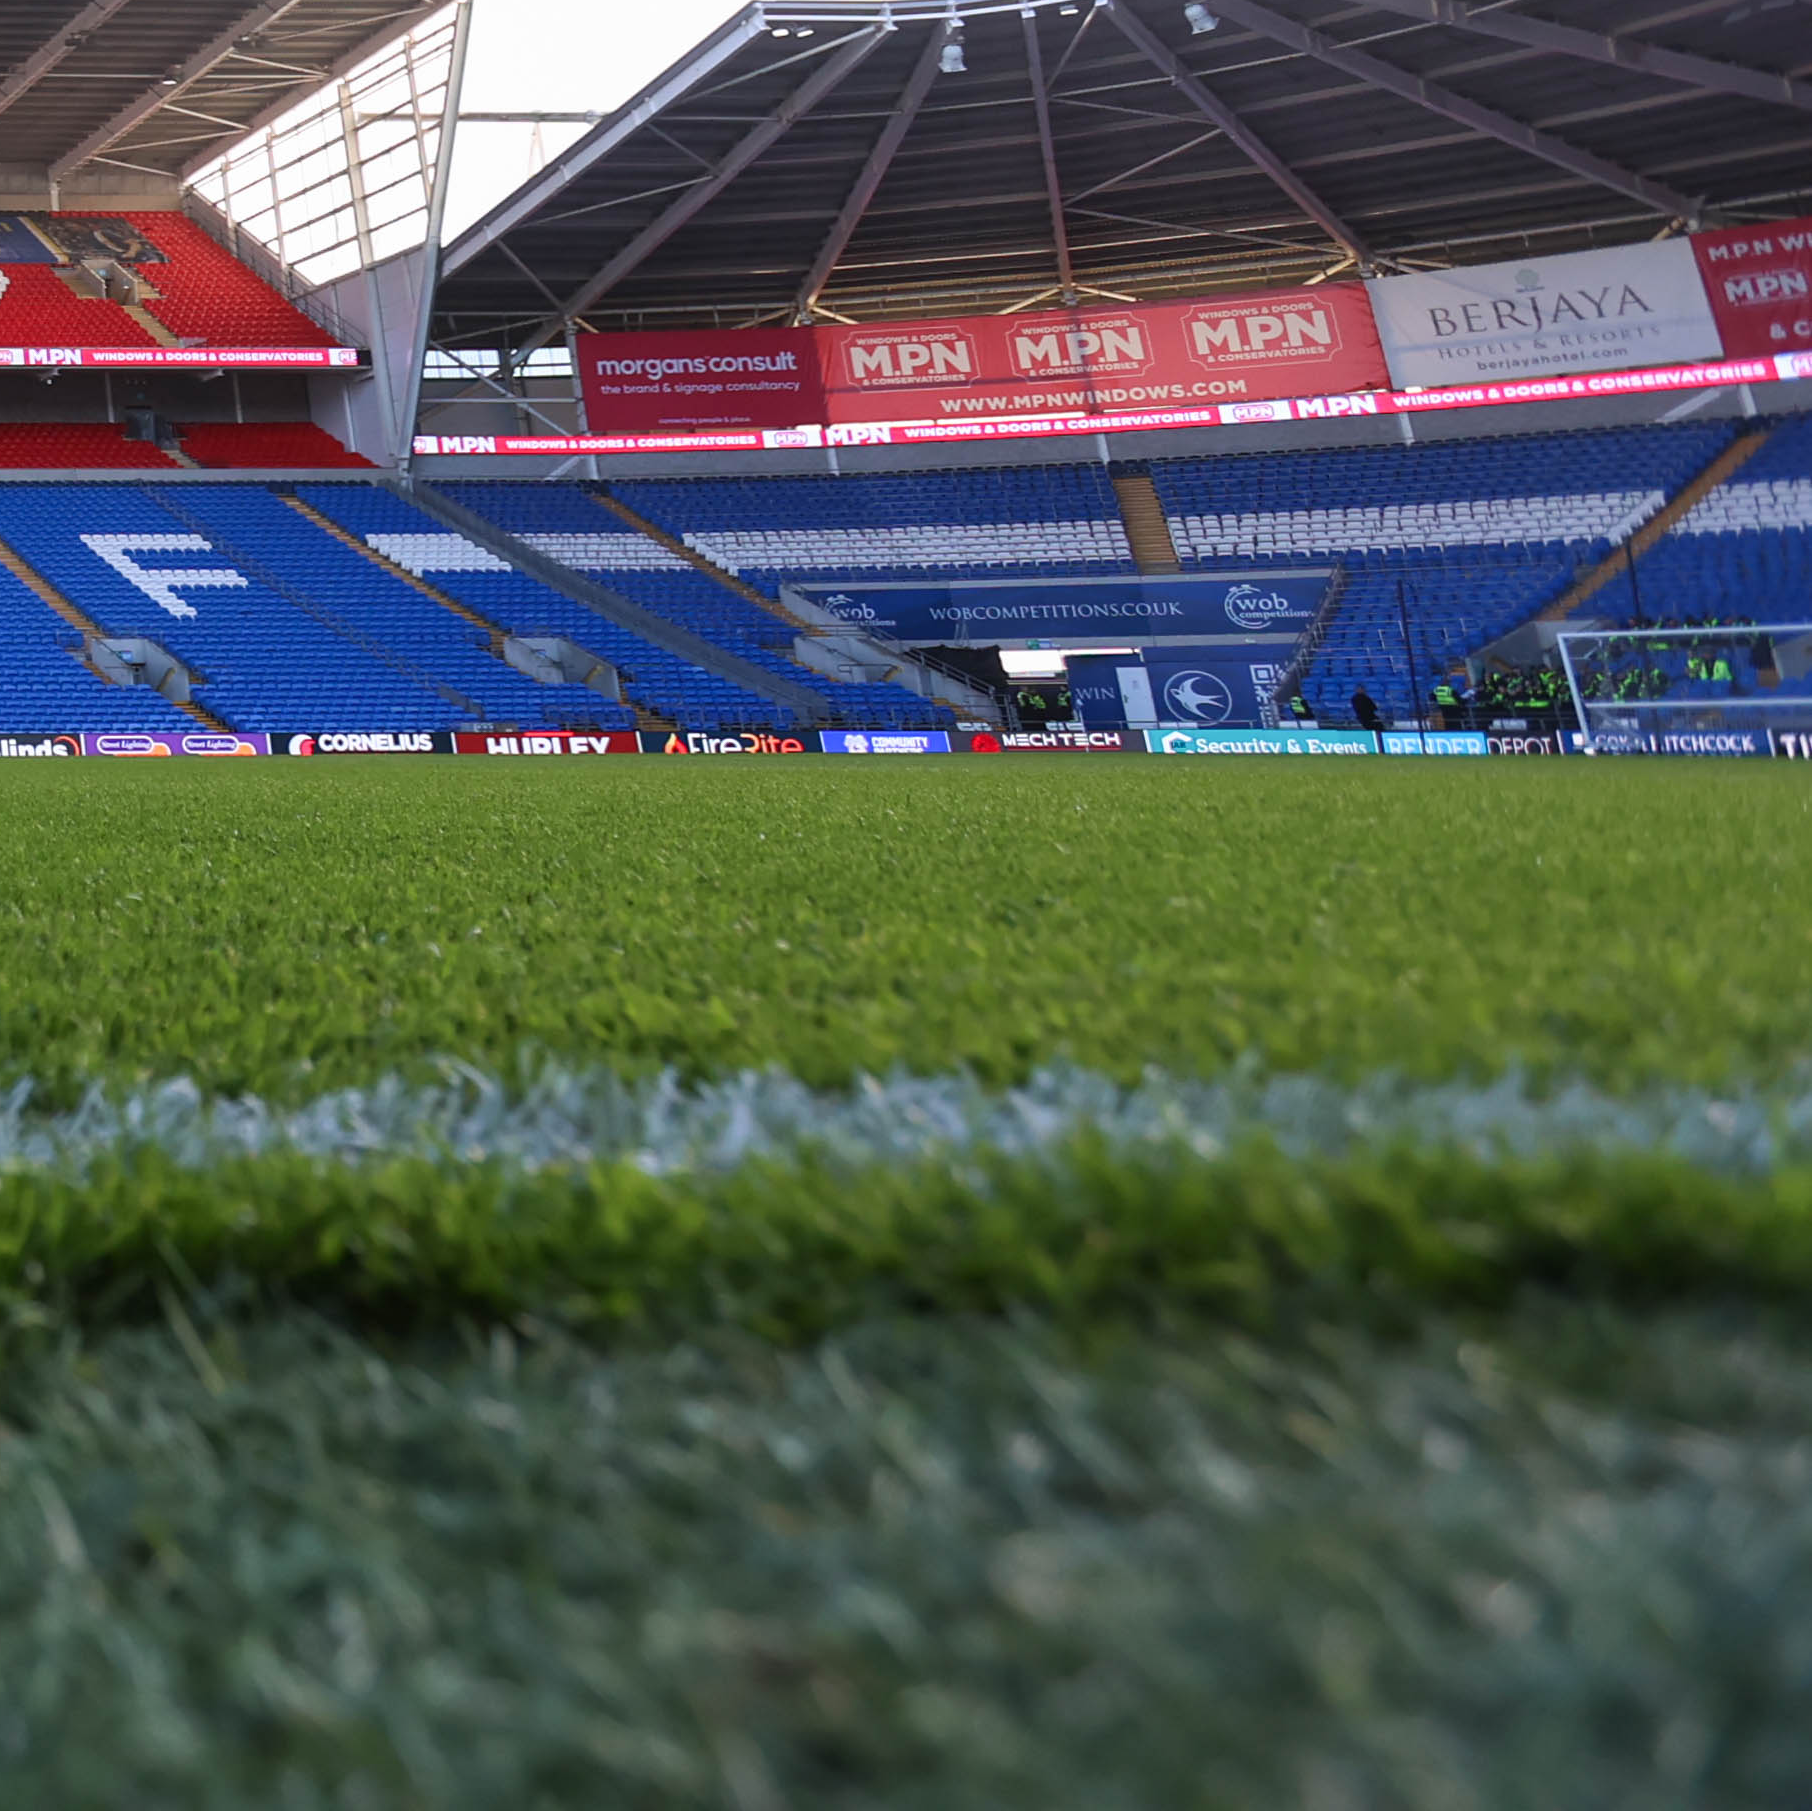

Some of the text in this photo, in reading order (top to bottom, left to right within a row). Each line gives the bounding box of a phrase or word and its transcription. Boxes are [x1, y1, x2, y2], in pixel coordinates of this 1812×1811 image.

[1197, 301, 1315, 320] WINDOWS DOORS
[1428, 284, 1655, 337] BERJAYA
[1021, 319, 1130, 336] WINDOWS DOORS
[855, 333, 958, 346] WINDOWS DOORS
[93, 352, 324, 362] WINDOWS CONSERVATORIES
[1218, 346, 1326, 362] CONSERVATORIES
[1438, 341, 1522, 360] HOTELS
[1477, 346, 1628, 371] berjayahotel.com
[1039, 361, 1140, 375] CONSERVATORIES
[601, 384, 621, 394] the
[623, 383, 659, 394] brand
[674, 381, 723, 395] signage
[726, 380, 801, 392] consultancy
[872, 373, 966, 386] CONSERVATORIES
[1394, 390, 1484, 407] WINDOWS
[1504, 382, 1567, 398] DOORS
[1588, 363, 1766, 391] CONSERVATORIES
[939, 379, 1248, 413] WWW.MPNWINDOWS.COM
[905, 425, 982, 438] WINDOWS
[997, 420, 1051, 433] DOORS
[1067, 410, 1211, 429] CONSERVATORIES
[506, 439, 570, 449] WINDOWS
[580, 438, 625, 449] DOORS
[637, 434, 756, 447] CONSERVATORIES
[1235, 592, 1288, 610] wob
[929, 601, 1185, 621] WOBCOMPETITIONS.CO.UK
[318, 734, 433, 751] CORNELIUS
[871, 737, 928, 747] COMMUNITY
[1306, 738, 1367, 754] Events
[1487, 737, 1552, 755] DEPOT
